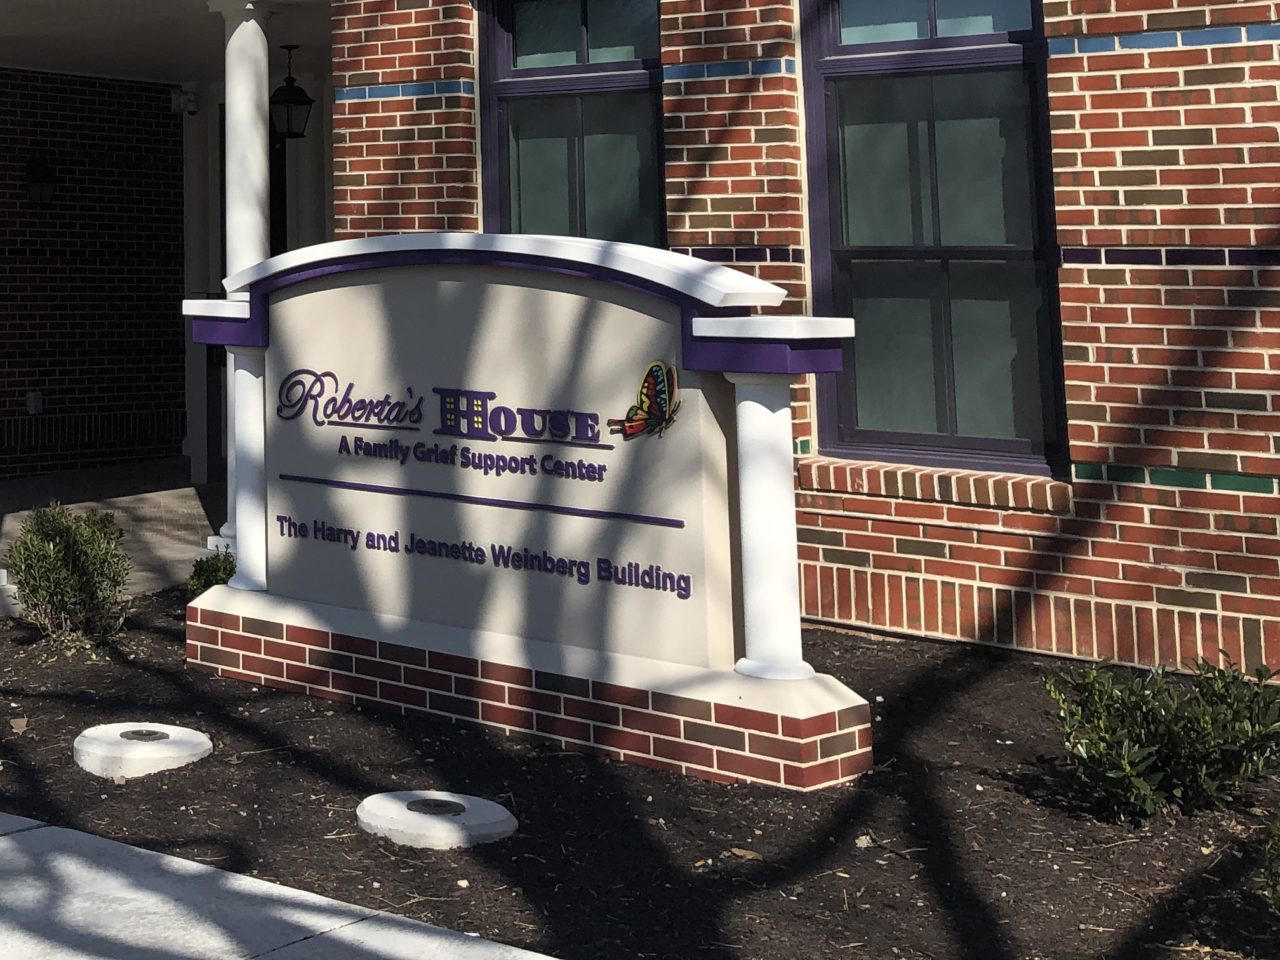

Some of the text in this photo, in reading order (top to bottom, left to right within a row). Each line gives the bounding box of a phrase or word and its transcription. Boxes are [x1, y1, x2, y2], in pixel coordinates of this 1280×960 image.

[277, 368, 424, 427] Roberta's
[338, 436, 608, 482] A Family Grief Support Center
[276, 515, 693, 599] The Harry and Jeanette Weinberg Building
